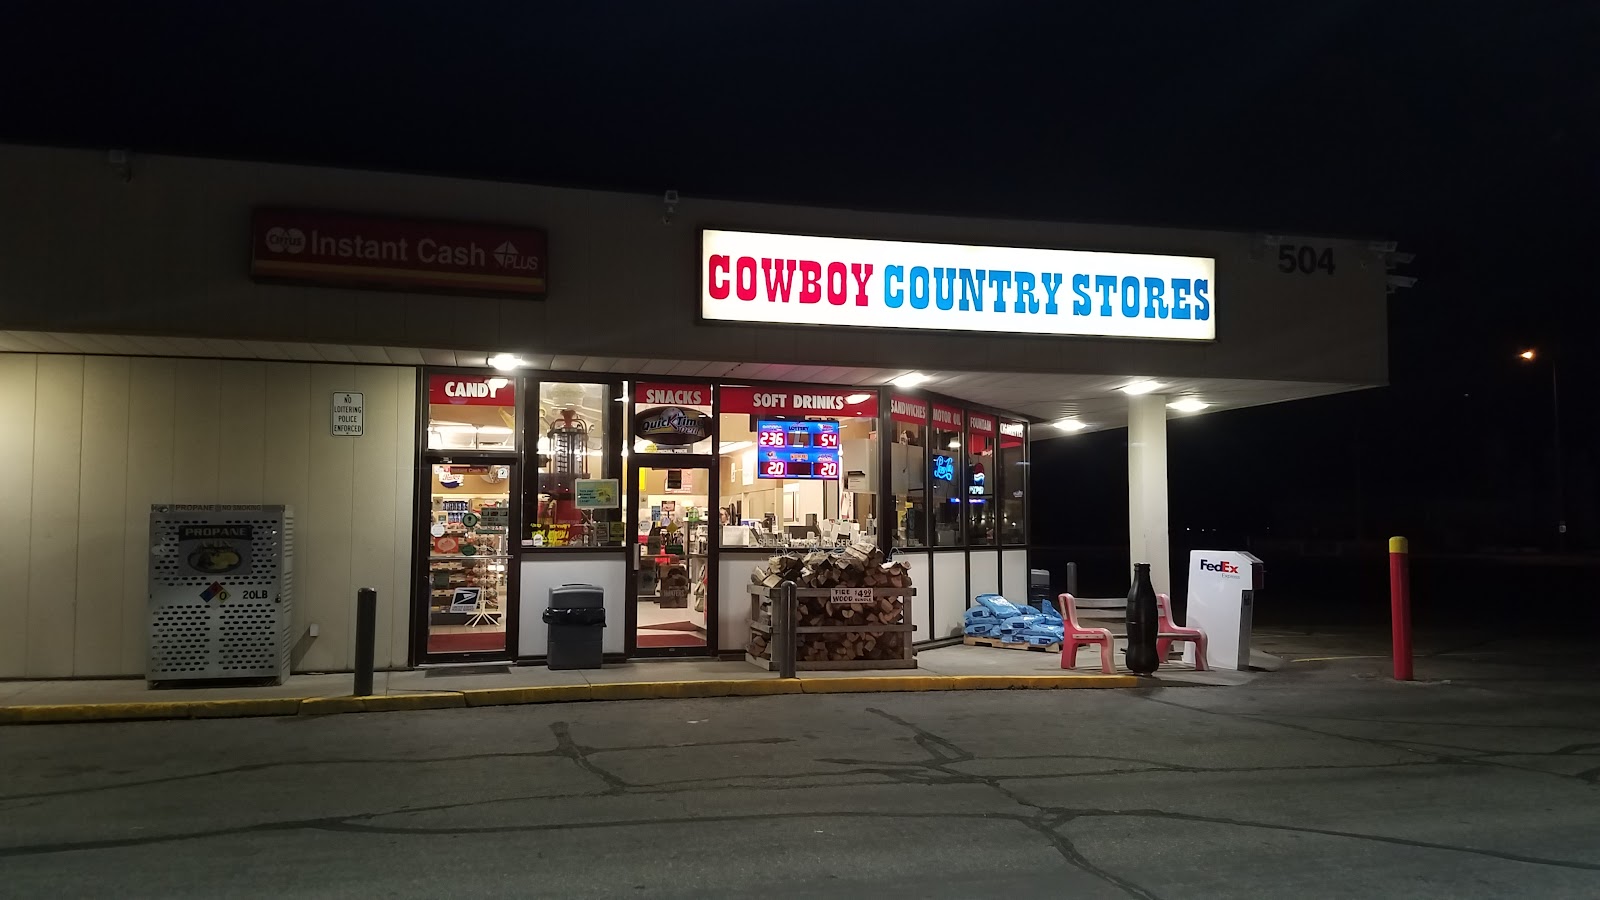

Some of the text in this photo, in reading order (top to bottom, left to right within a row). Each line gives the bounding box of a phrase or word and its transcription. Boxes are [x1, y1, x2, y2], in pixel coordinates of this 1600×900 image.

[311, 230, 486, 266] Instant Cash
[505, 254, 539, 271] PLUS
[1277, 244, 1336, 275] 504
[708, 254, 1211, 321] COWBOY COUNTRY STORES
[444, 381, 502, 398] CANDY
[646, 389, 702, 405] SNACKS
[344, 396, 352, 404] NO
[753, 393, 845, 410] SOFT DRINKS
[334, 405, 362, 414] LOITERING
[890, 399, 926, 419] SANDWICHES
[932, 408, 952, 424] MOTOR
[338, 415, 357, 423] POLICE
[969, 416, 992, 432] FOUNTAIN
[334, 424, 362, 433] ENFORCED
[759, 432, 784, 446] 236
[821, 433, 837, 447] 54
[820, 463, 837, 477] 20
[184, 527, 248, 537] PROPANE
[1200, 559, 1239, 574] FedEx
[242, 590, 268, 600] 20LB
